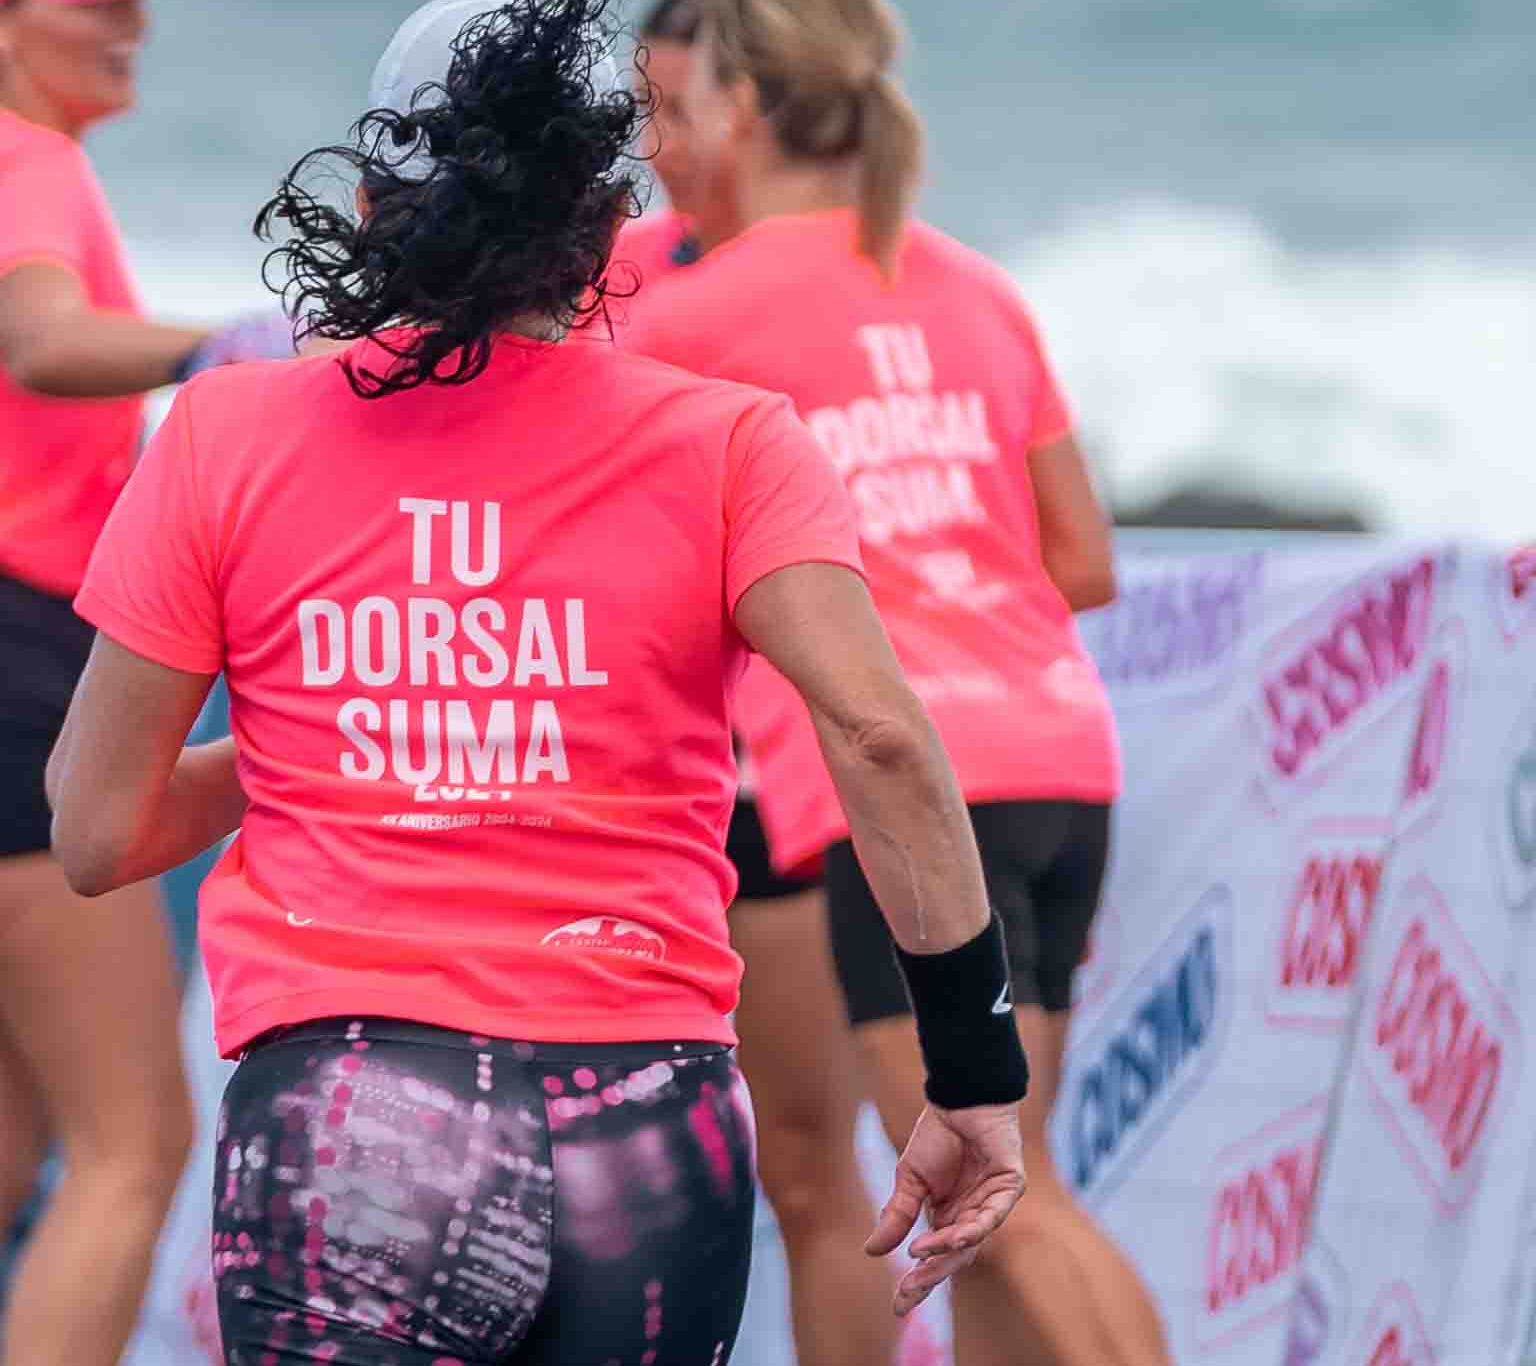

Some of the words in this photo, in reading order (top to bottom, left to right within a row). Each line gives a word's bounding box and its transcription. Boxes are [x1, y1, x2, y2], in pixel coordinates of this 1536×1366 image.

[399, 497, 502, 586] TU
[297, 596, 609, 687] DORSAL
[336, 698, 570, 785] SUMA
